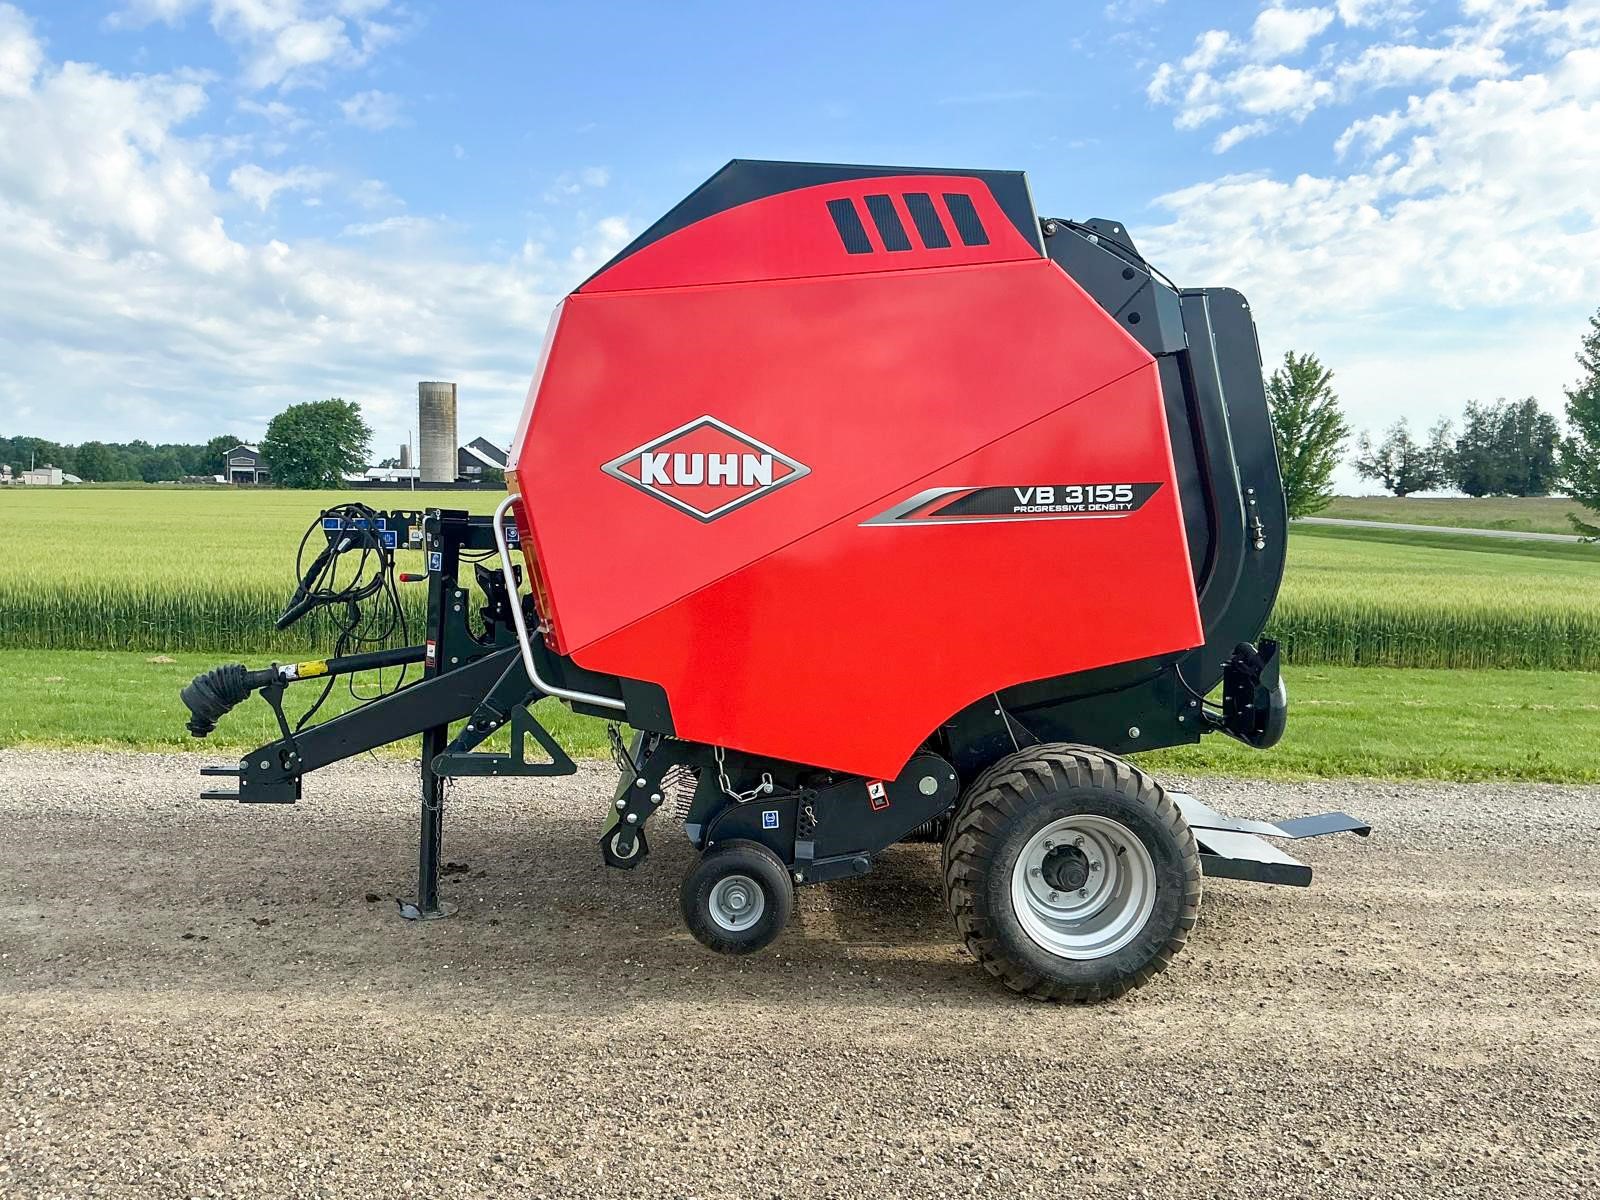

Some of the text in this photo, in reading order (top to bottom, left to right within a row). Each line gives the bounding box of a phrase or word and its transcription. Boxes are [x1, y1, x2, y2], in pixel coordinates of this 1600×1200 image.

[641, 452, 773, 486] KUHN
[1013, 485, 1133, 504] VB 3155
[1013, 503, 1132, 513] PROGRESSIVE DENSITY
